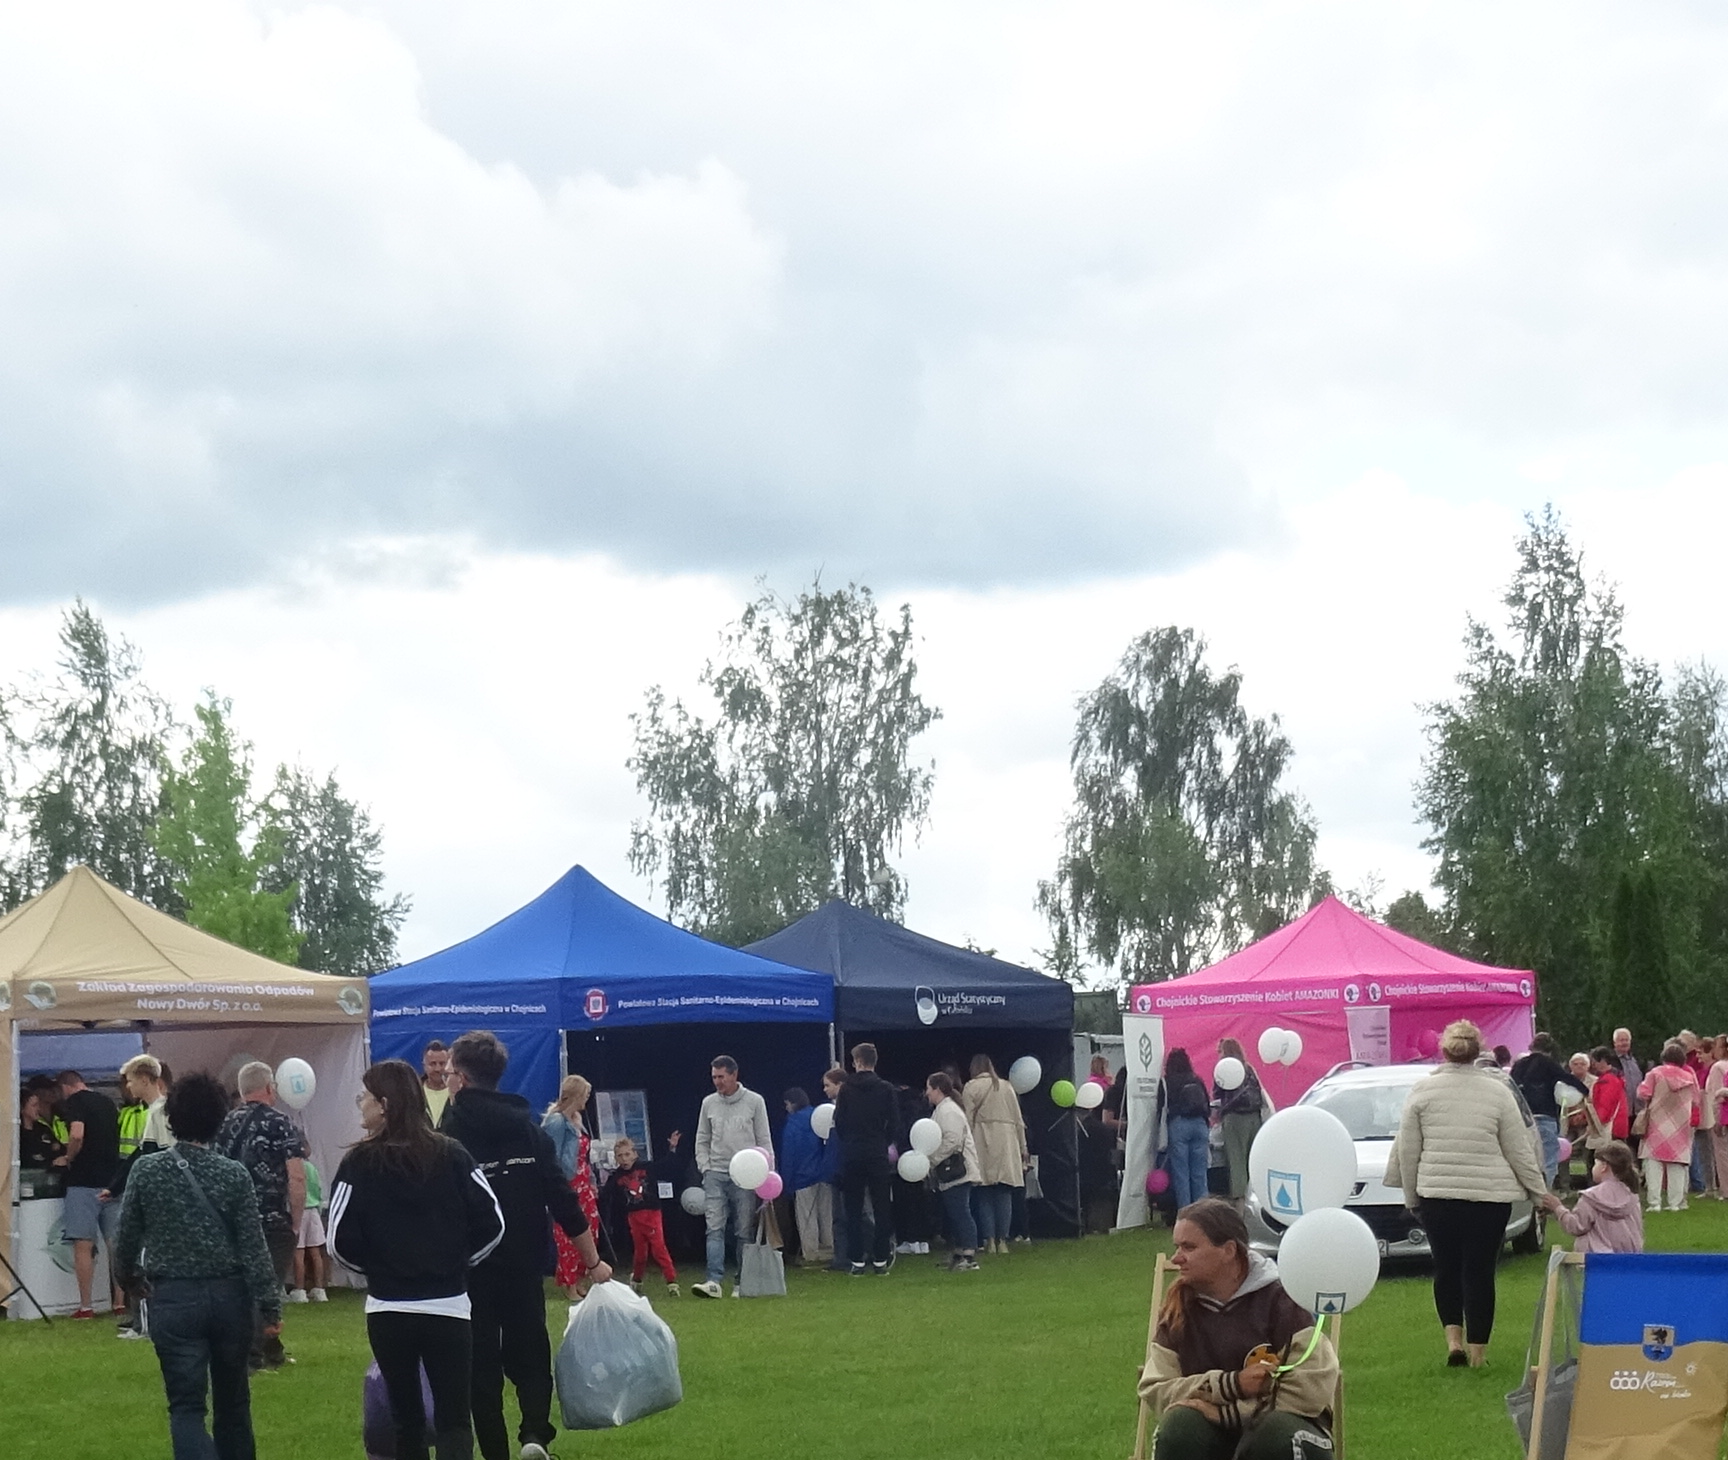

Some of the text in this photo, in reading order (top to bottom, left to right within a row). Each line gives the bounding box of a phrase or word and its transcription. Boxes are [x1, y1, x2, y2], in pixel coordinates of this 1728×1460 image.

[128, 982, 254, 996] Zagospodarowania
[255, 984, 315, 997] Odpadów
[137, 998, 174, 1012] Nowy
[177, 998, 210, 1010] Dwór
[212, 999, 231, 1012] Sp.
[1156, 988, 1339, 1008] Chojnickie Stowarzyszenie Kobiet AMAZONKI
